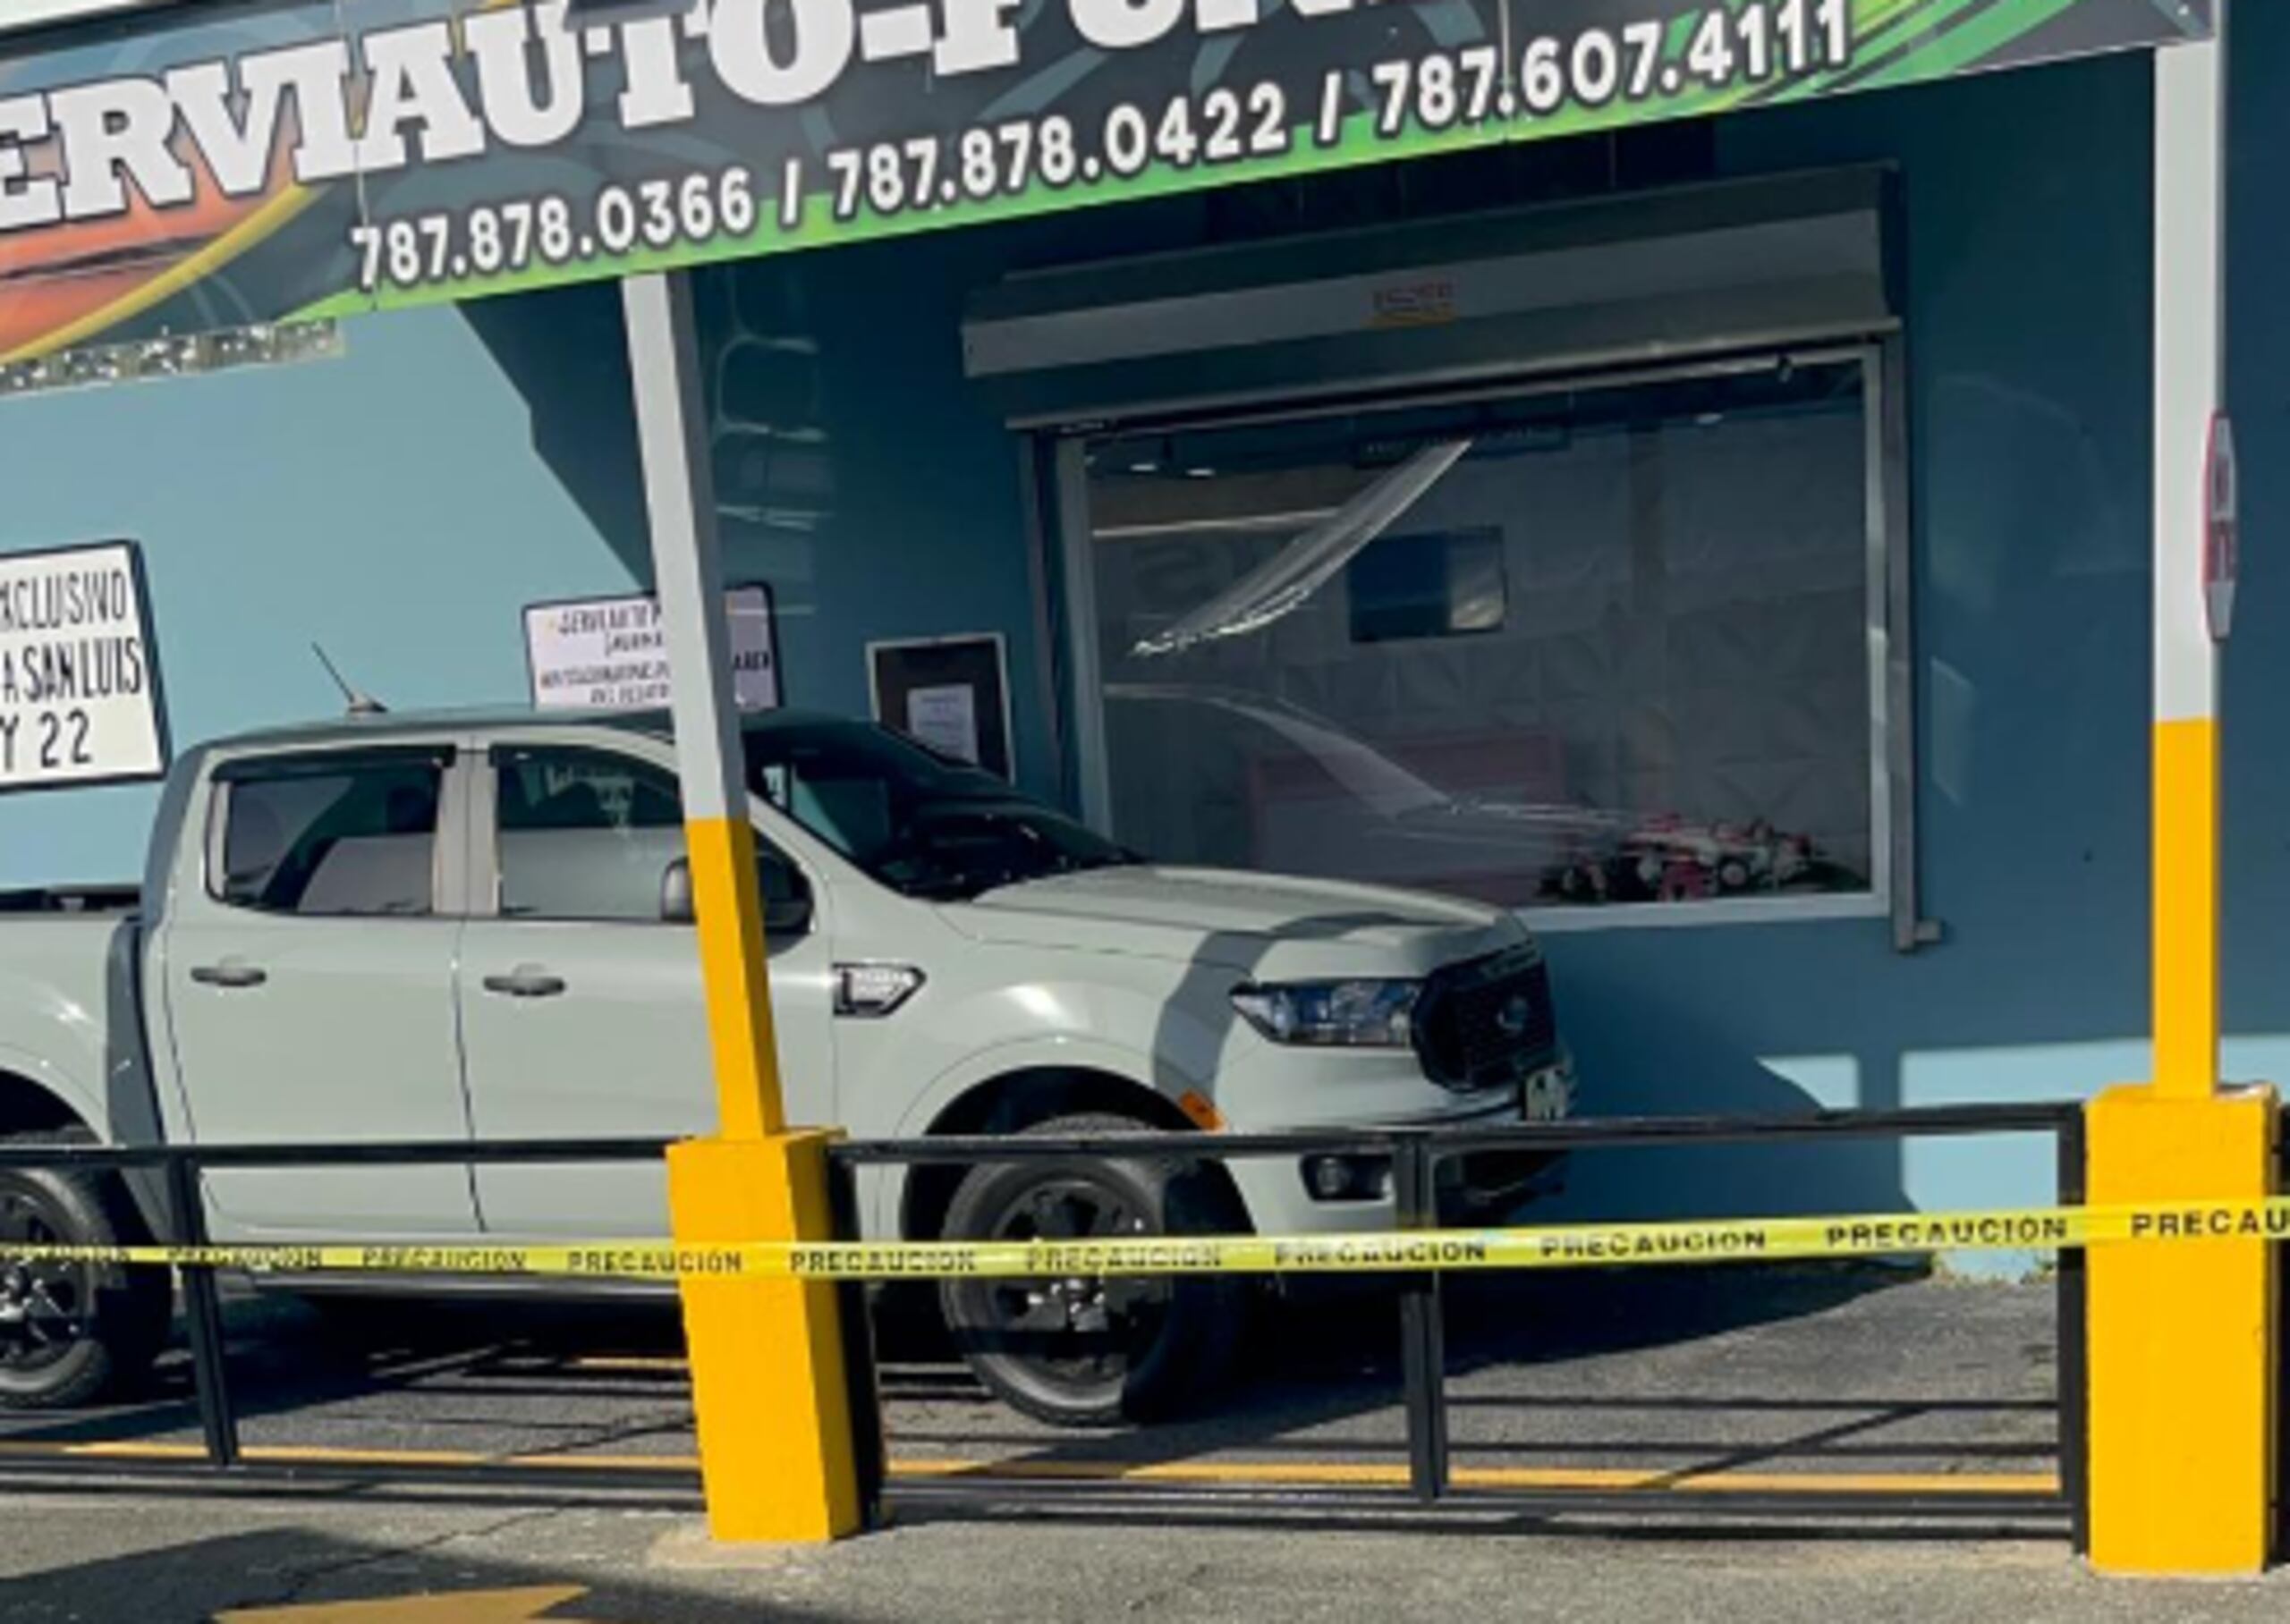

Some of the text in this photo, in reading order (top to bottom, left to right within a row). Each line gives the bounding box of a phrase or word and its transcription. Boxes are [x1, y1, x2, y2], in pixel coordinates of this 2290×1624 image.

[351, 0, 1845, 289] 787.878.0366 / 787.878.0422 / 787.607.4111
[22, 641, 75, 703] SAN
[79, 637, 142, 699] LUIS
[38, 706, 92, 769] 22
[566, 1250, 742, 1273] PRECAUCION
[790, 1250, 975, 1273] PRECAUCION
[1540, 1229, 1765, 1257] PRECAUCION
[1827, 1216, 2067, 1248] PRECAUCION
[2131, 1207, 2290, 1237] PRECAU
